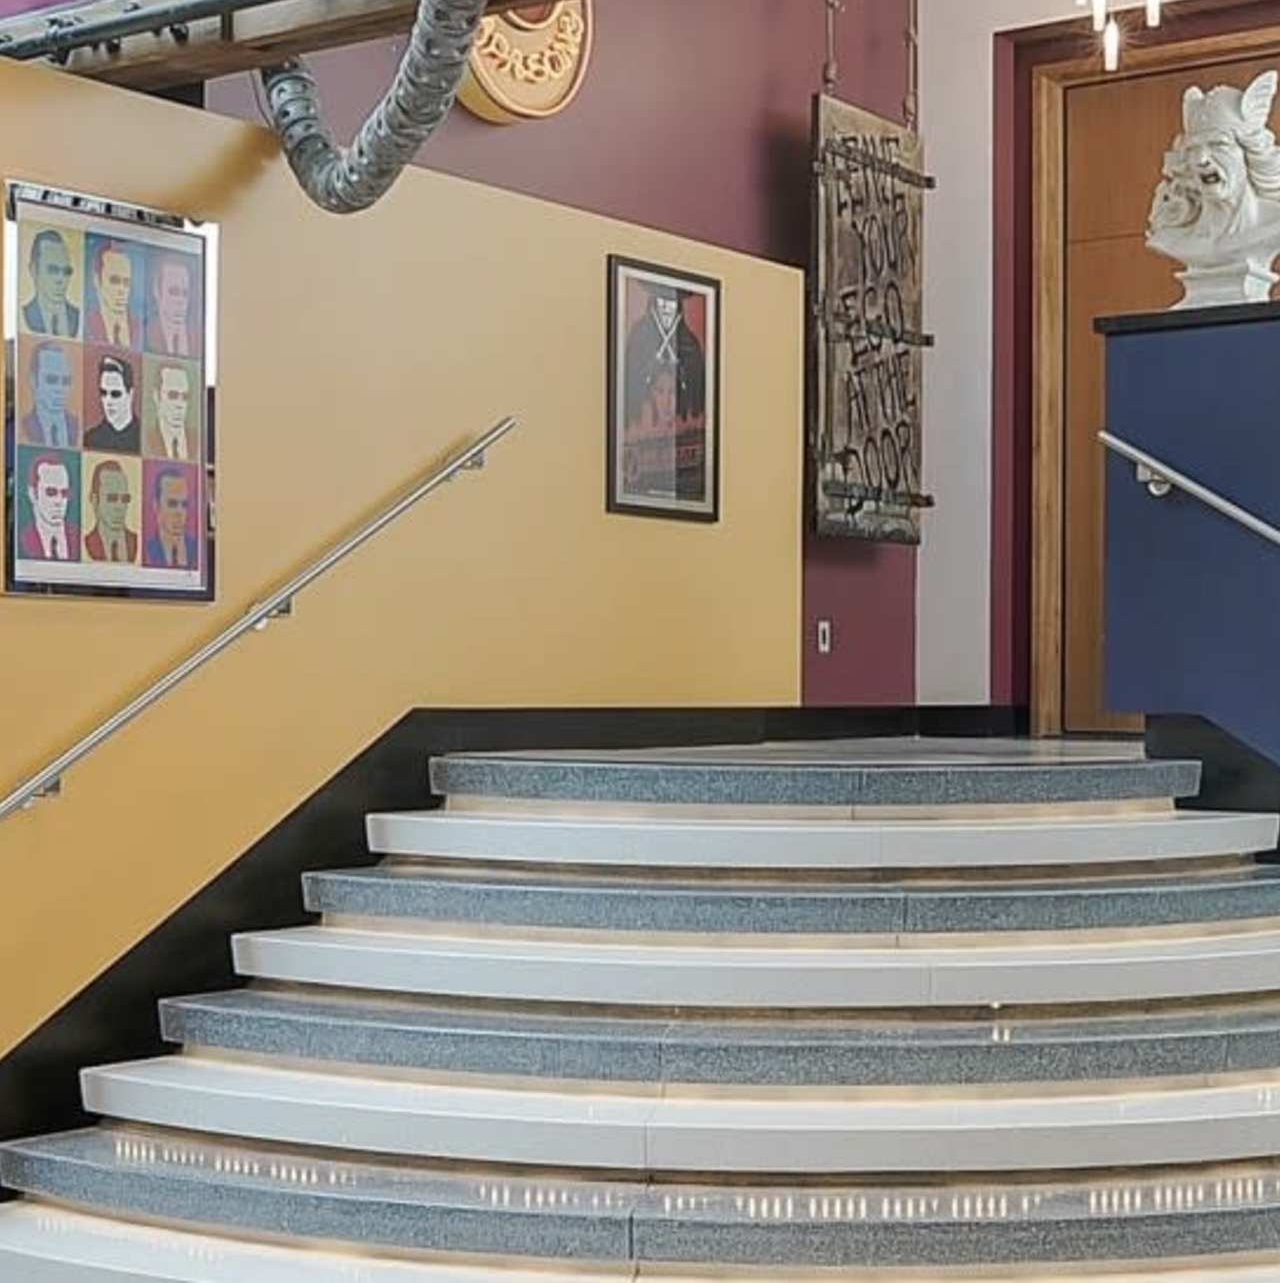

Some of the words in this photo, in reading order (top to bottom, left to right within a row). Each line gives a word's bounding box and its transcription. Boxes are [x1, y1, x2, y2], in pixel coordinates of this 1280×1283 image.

[833, 135, 905, 216] LEAVE
[851, 209, 916, 286] YOUR
[839, 281, 905, 367] EGO
[846, 367, 876, 443] AT
[873, 350, 916, 429] THE
[837, 419, 918, 515] DOOR
